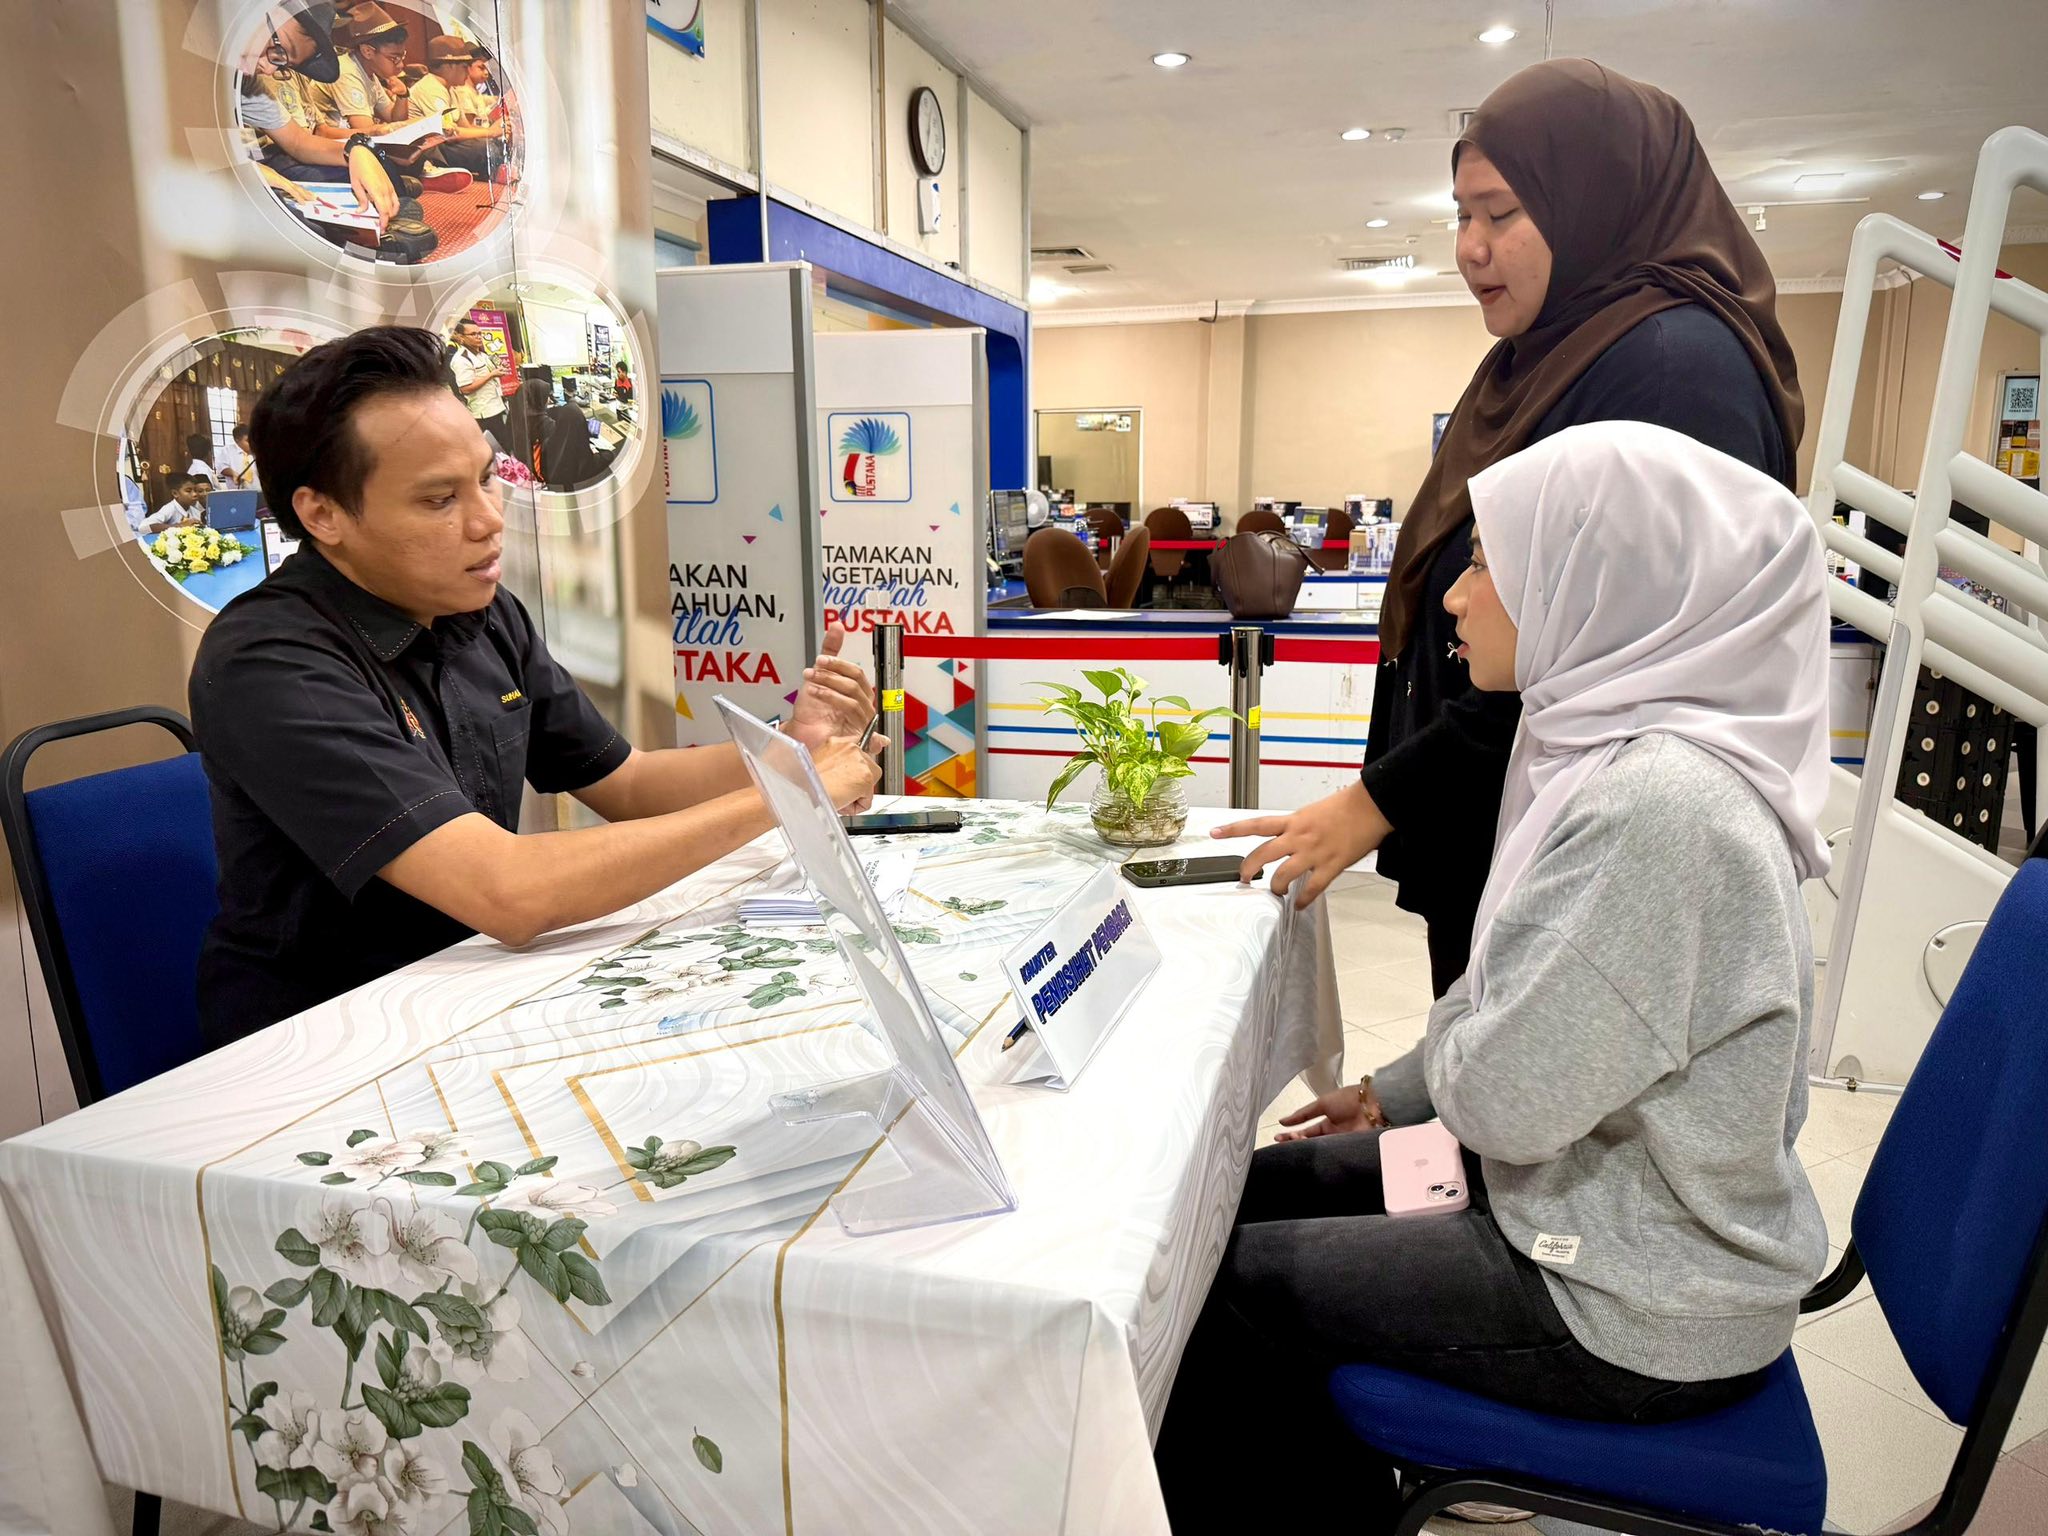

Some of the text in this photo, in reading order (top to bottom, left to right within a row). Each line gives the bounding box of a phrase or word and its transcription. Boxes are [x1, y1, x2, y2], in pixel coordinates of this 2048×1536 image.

[865, 455, 876, 496] PUSTAKA
[823, 546, 932, 564] TAMAKAN
[670, 563, 748, 588] AKAN
[671, 592, 785, 622] AHUAN,
[824, 609, 955, 634] PUSTAKA
[673, 650, 781, 684] TAKA
[1019, 941, 1057, 985] KAUNTER
[1031, 898, 1133, 1024] PENASIHAT PEMBACA
